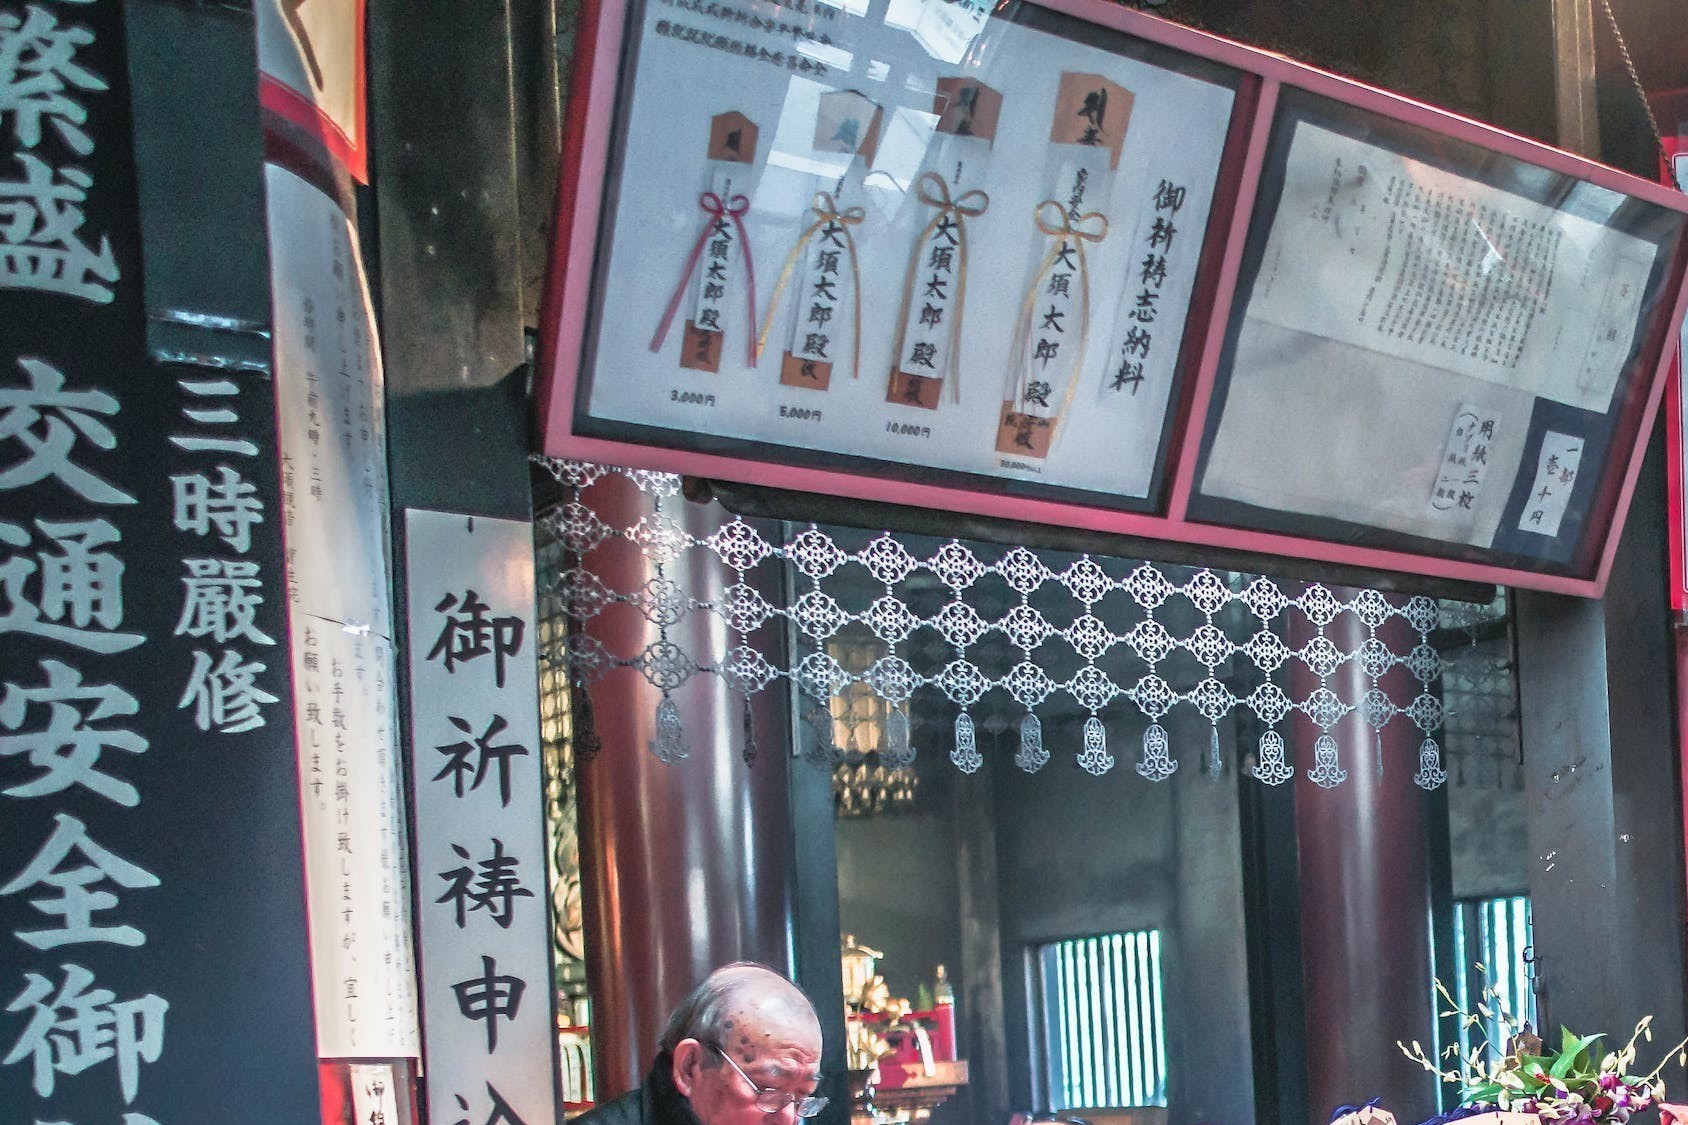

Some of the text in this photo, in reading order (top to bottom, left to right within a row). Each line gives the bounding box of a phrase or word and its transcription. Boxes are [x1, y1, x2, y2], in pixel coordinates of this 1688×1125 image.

[700, 218, 732, 330] 大須太郎殿
[803, 219, 845, 359] 大須太郎殿
[910, 215, 959, 370] 大須太郎殿
[1025, 241, 1077, 408] 大須太郎殿
[1109, 178, 1187, 398] 御祈祷志納料
